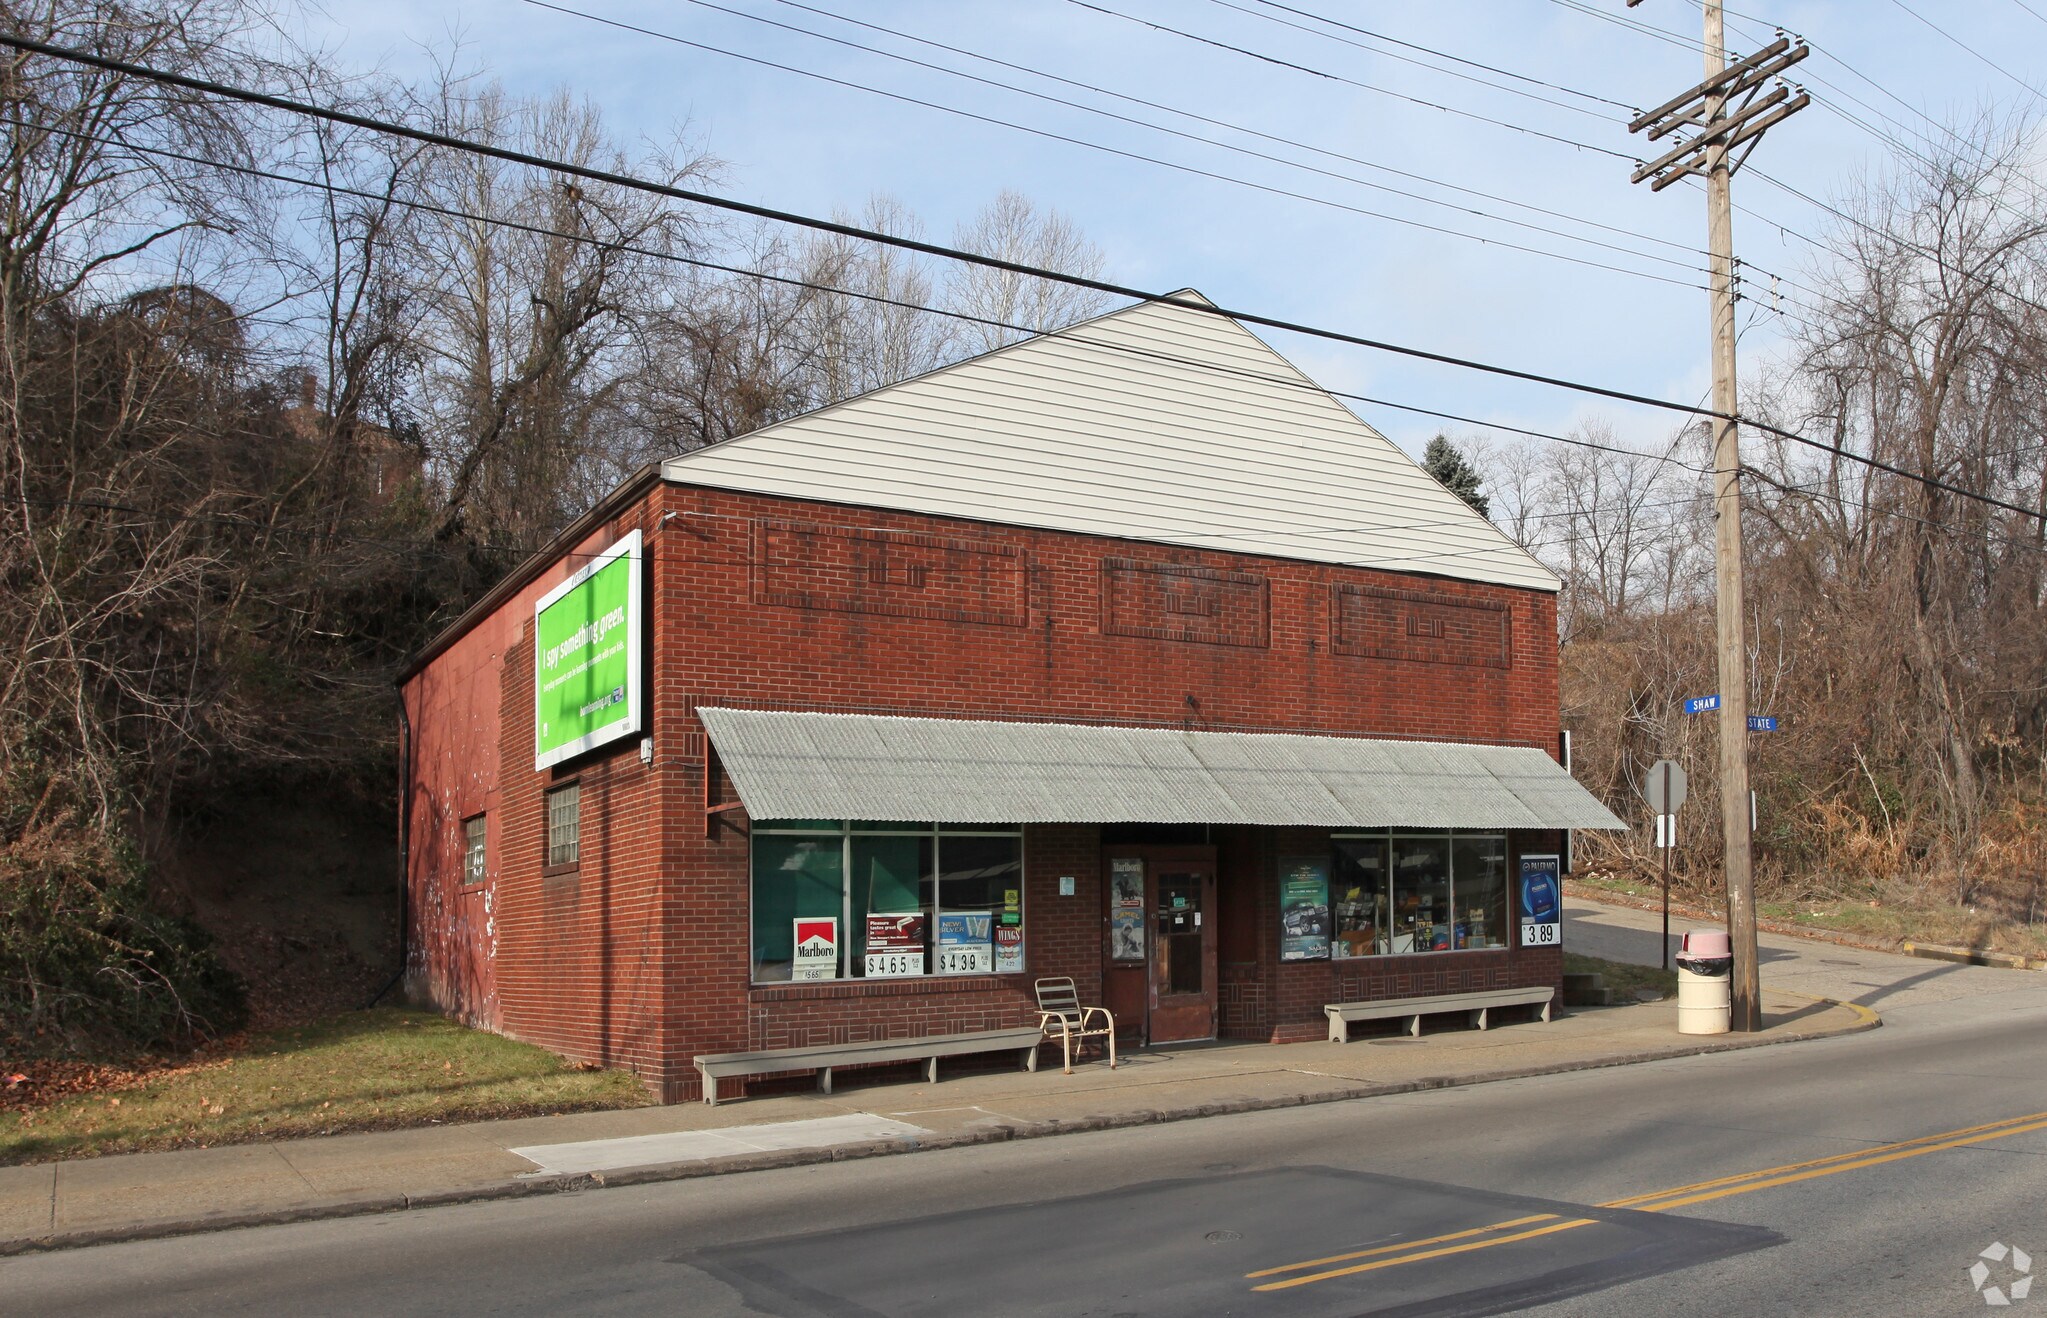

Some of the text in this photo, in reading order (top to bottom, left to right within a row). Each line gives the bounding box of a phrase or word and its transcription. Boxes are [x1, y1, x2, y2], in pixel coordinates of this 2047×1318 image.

[543, 606, 624, 670] I spy something green.
[1693, 697, 1716, 711] SHAW
[1748, 717, 1771, 729] STATE
[1113, 862, 1140, 872] Marlboro
[1531, 862, 1555, 870] PALERMO
[1114, 911, 1140, 920] CAMEL
[998, 929, 1020, 941] WINGS
[797, 942, 834, 957] Marlboro
